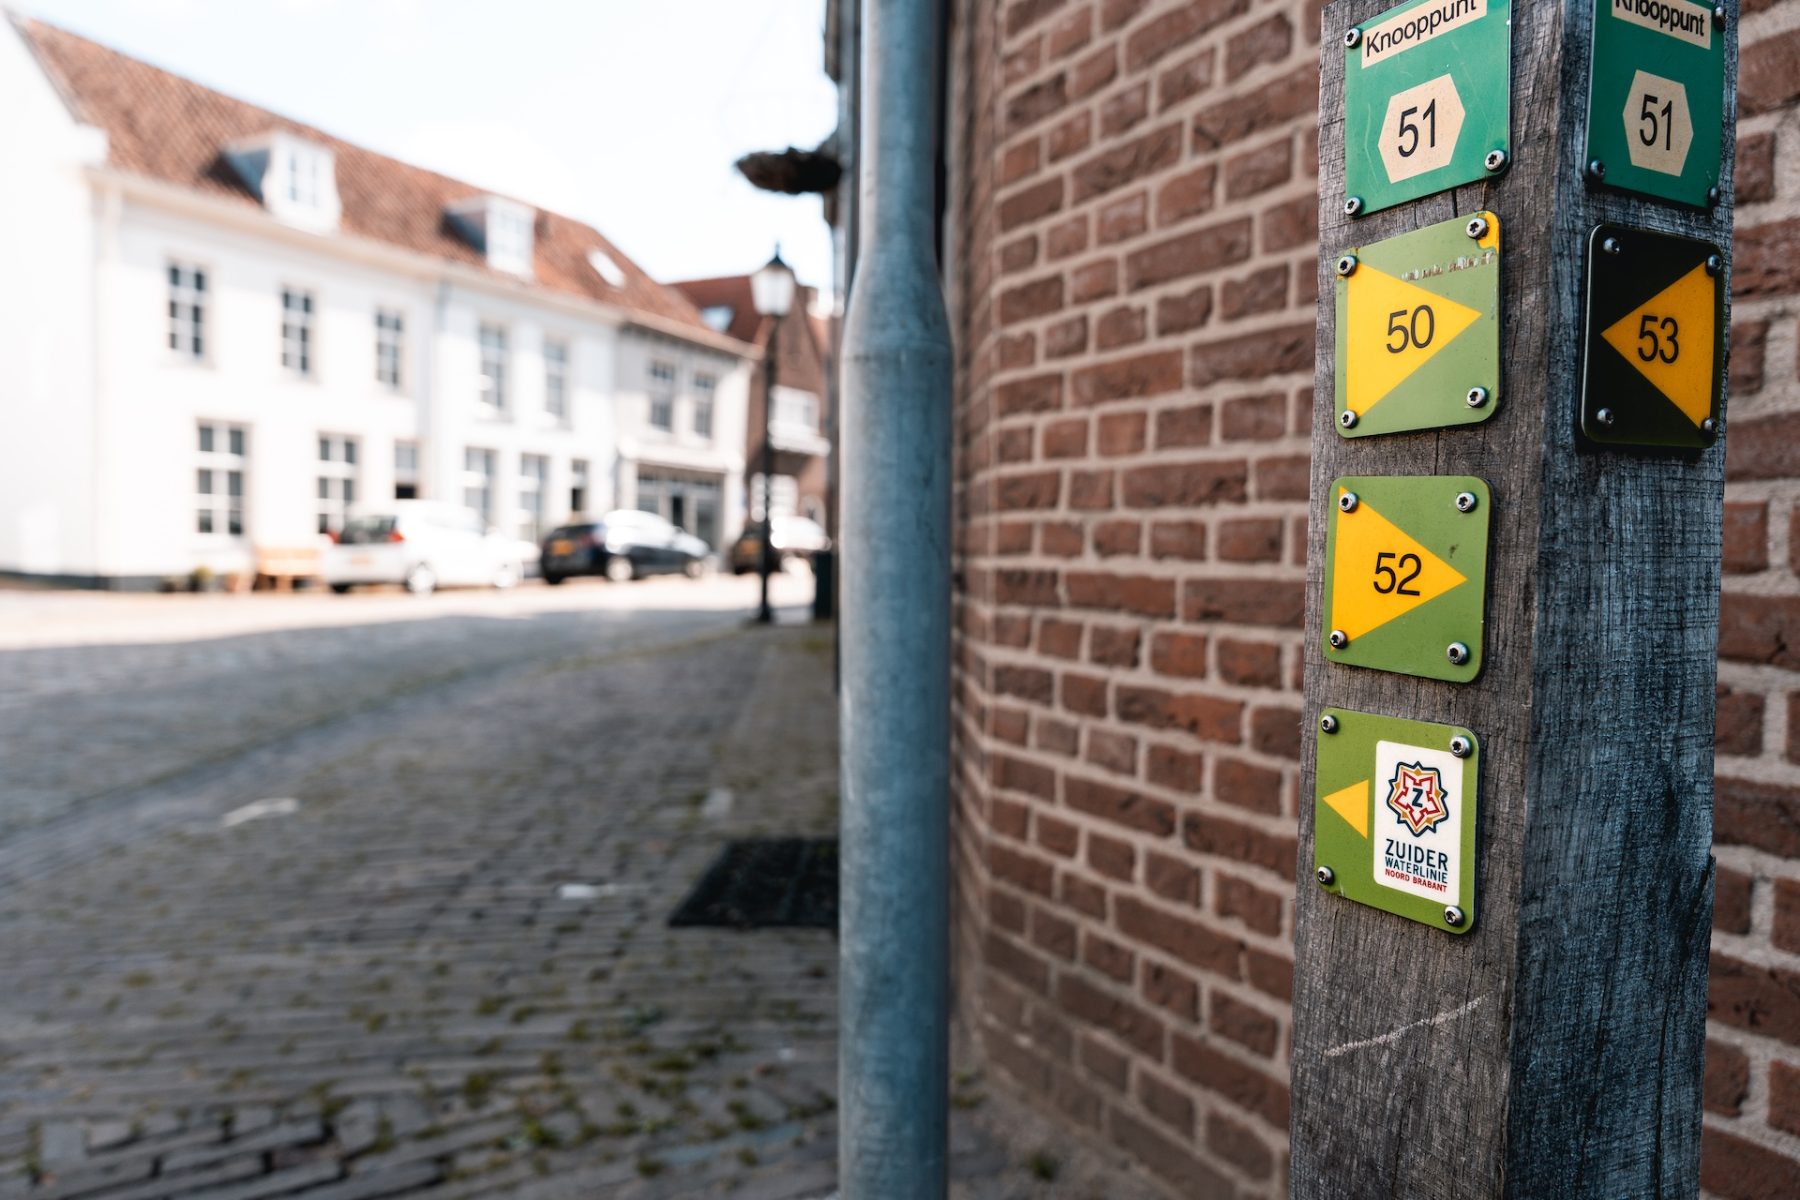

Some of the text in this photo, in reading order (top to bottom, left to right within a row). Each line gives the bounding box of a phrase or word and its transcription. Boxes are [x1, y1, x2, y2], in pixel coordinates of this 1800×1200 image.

[1397, 98, 1436, 158] 51
[1639, 94, 1672, 151] 51
[1386, 304, 1435, 354] 50
[1637, 314, 1679, 364] 53
[1373, 552, 1422, 596] 52
[1411, 787, 1423, 808] Z
[1385, 838, 1448, 871] ZUIDER
[1385, 857, 1448, 883] WATERLINIE
[1385, 869, 1447, 892] NOORD BRABANT
